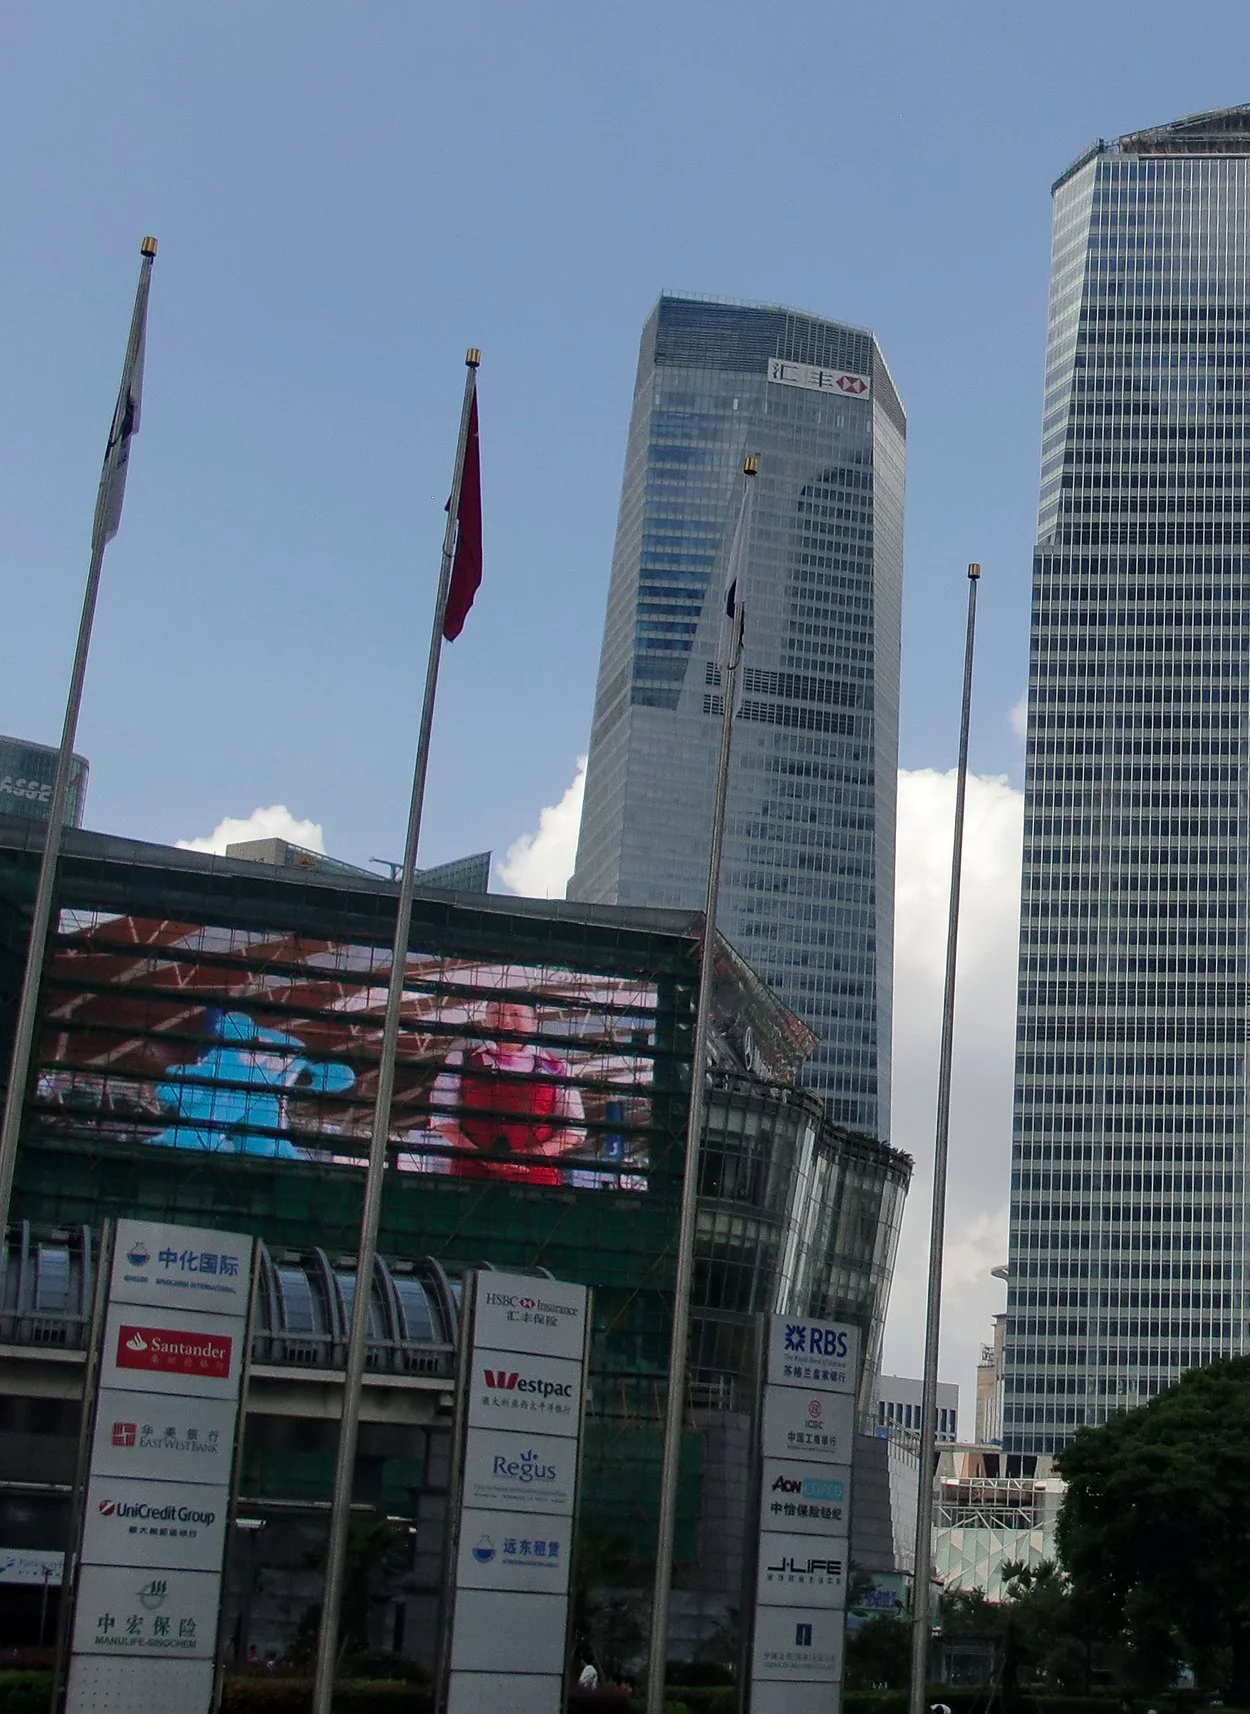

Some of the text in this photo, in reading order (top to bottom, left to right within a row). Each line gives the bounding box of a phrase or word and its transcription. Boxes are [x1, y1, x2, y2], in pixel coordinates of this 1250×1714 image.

[771, 361, 834, 388] 汇丰
[158, 1247, 239, 1276] 中化国际
[486, 1293, 578, 1316] HSBC Insurance
[507, 1311, 558, 1327] 汇丰保险
[151, 1337, 226, 1358] Santander
[809, 1327, 848, 1358] RBS
[484, 1369, 572, 1398] Westpac
[140, 1436, 219, 1453] EAST WEST BANK
[493, 1455, 557, 1482] Regus
[117, 1503, 216, 1527] UniCredit Group
[503, 1537, 560, 1557] 远东租赁
[97, 1613, 196, 1637] 中宏保险
